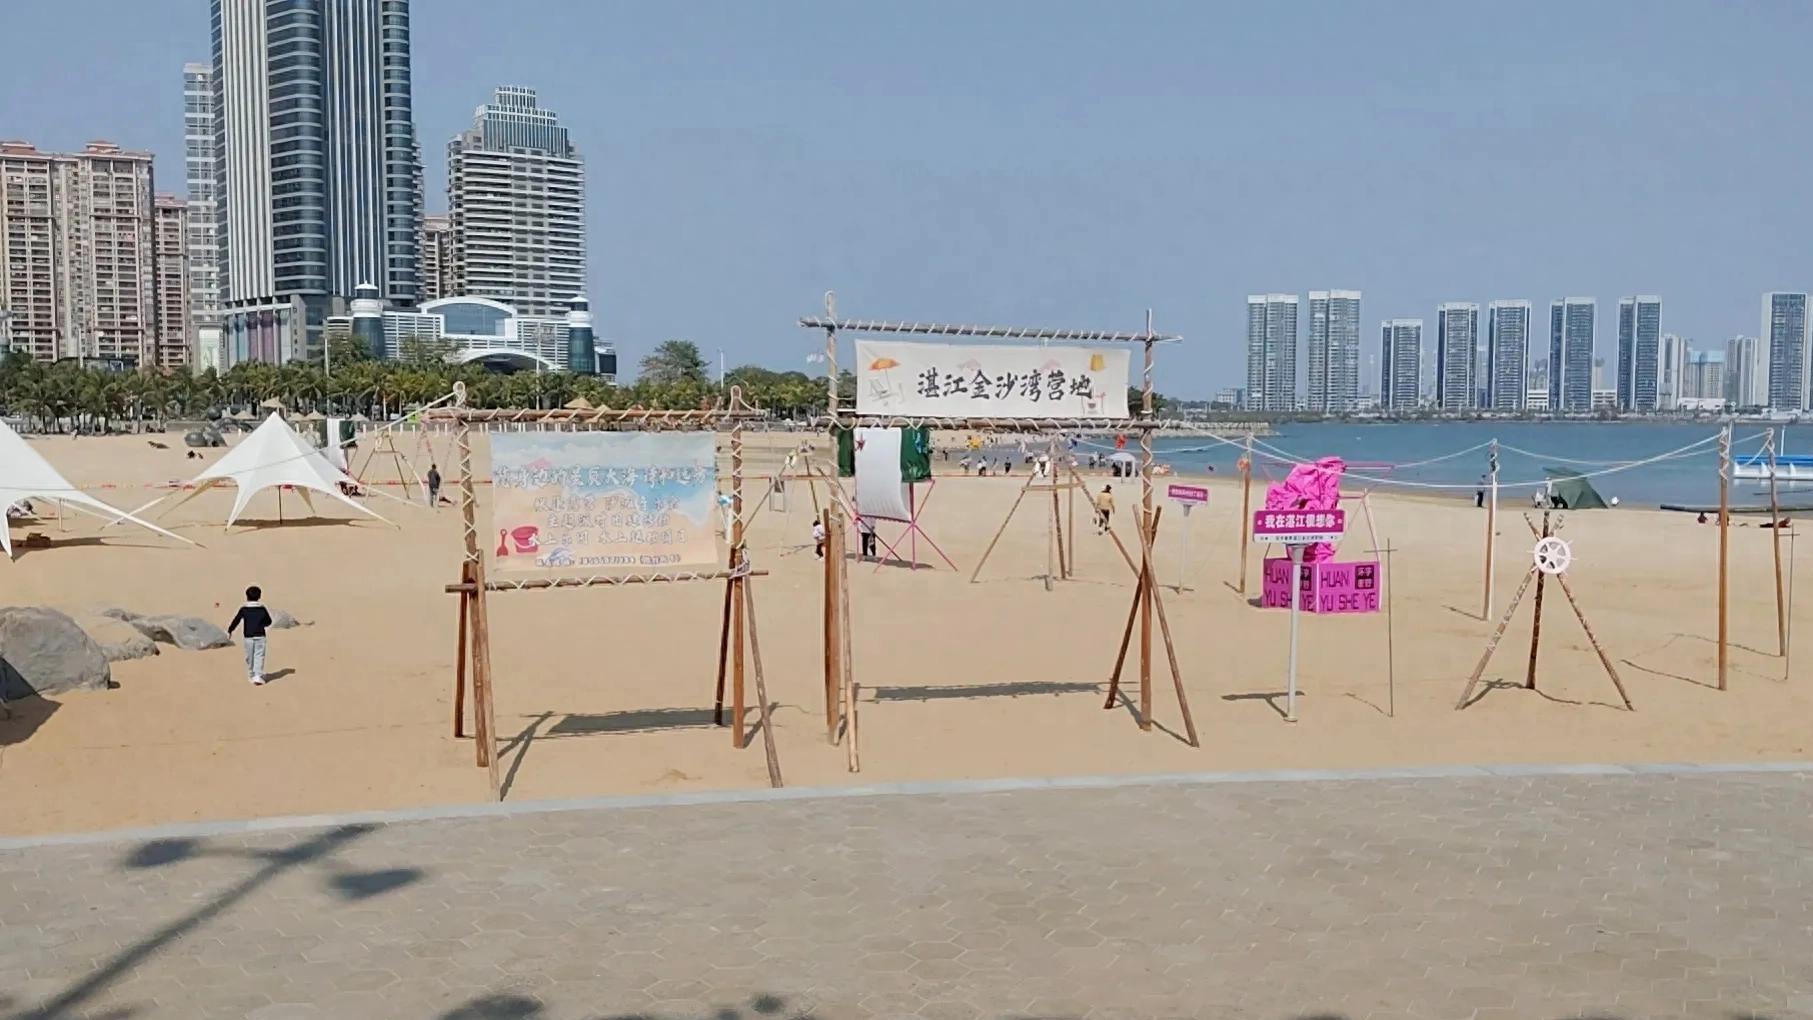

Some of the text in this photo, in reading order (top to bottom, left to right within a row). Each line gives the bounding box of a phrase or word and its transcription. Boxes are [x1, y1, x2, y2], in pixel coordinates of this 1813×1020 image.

[917, 366, 1093, 402] 湛江金沙湾营地
[1265, 514, 1336, 528] 我在湛江很想你
[1264, 567, 1289, 584] HUAN
[1320, 571, 1349, 588] HUAN
[1264, 590, 1277, 607] YU
[1320, 592, 1377, 611] YU SHE YE
